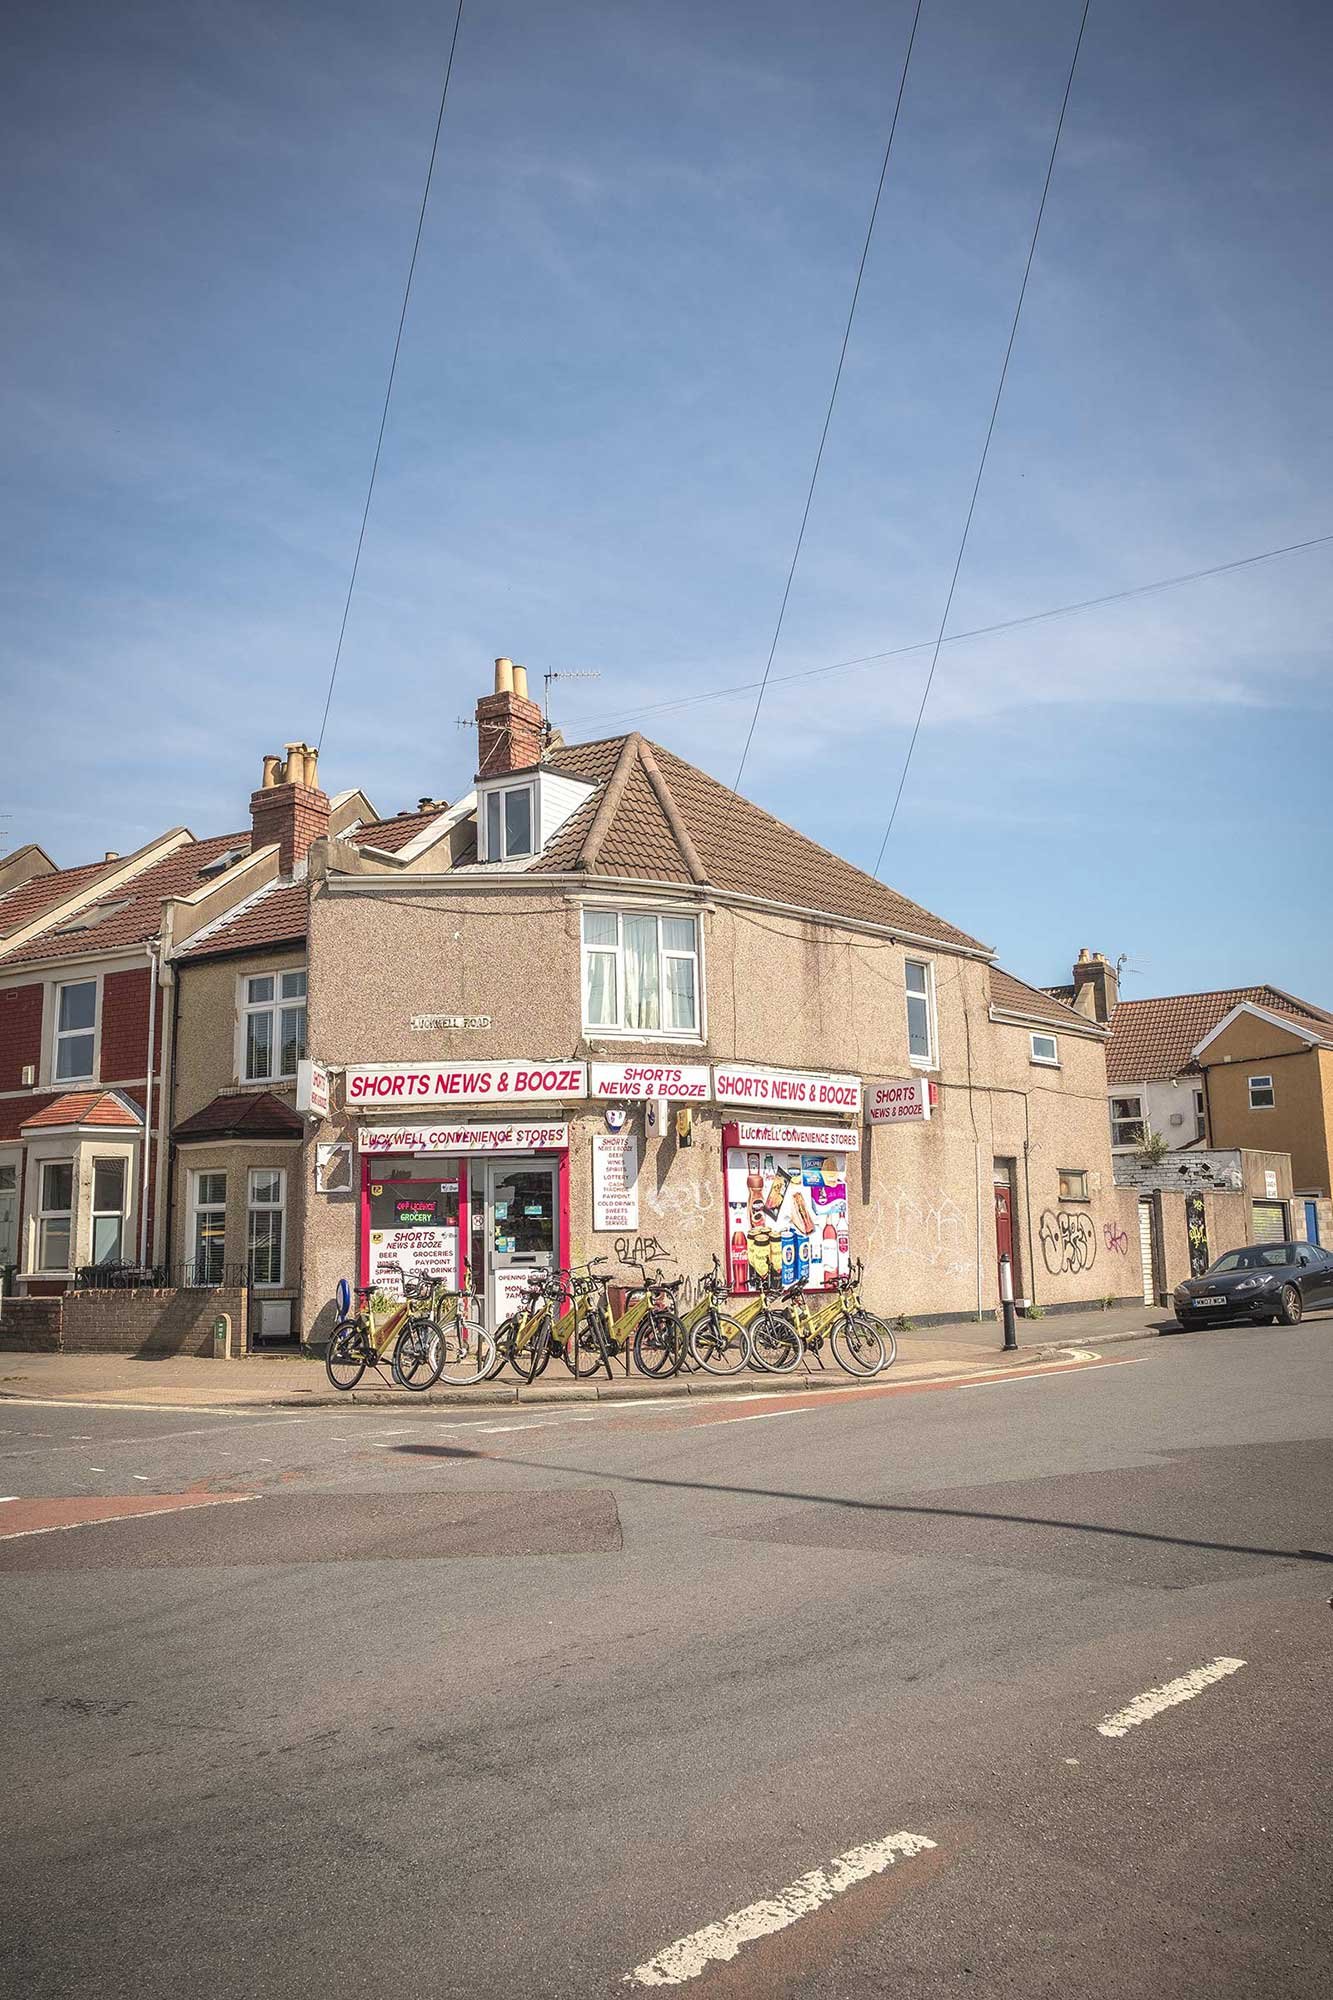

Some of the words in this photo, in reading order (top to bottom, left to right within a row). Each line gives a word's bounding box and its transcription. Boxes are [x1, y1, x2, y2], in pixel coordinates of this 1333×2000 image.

[463, 1018, 489, 1028] ROAD
[623, 1068, 682, 1082] SHORTS
[350, 1074, 430, 1098] SHORTS
[435, 1072, 491, 1094] NEWS
[497, 1072, 509, 1092] &
[514, 1070, 582, 1092] BOOZE
[598, 1081, 641, 1095] NEWS
[645, 1084, 654, 1095] &
[658, 1083, 706, 1097] BOOZE
[718, 1075, 768, 1098] SHORTS
[771, 1080, 806, 1100] NEWS
[809, 1084, 816, 1102] &
[819, 1086, 857, 1106] BOOZE
[876, 1087, 915, 1103] SHORTS
[870, 1108, 890, 1118] NEWS
[892, 1107, 896, 1116] &
[898, 1104, 922, 1116] BOOZE
[361, 1131, 424, 1146] LUCKWELL
[429, 1129, 513, 1144] CONVENIENCE
[516, 1128, 563, 1142] STORES
[602, 1138, 629, 1146] SHORTS
[740, 1125, 779, 1142] LUCKWELL
[781, 1129, 829, 1144] CONVENIENCE
[830, 1133, 856, 1146] STORES
[400, 1213, 432, 1222] GROCERY
[393, 1232, 436, 1242] SHORTS
[386, 1241, 409, 1249] NEWS
[410, 1241, 415, 1249] &
[416, 1241, 442, 1249] BOOZE
